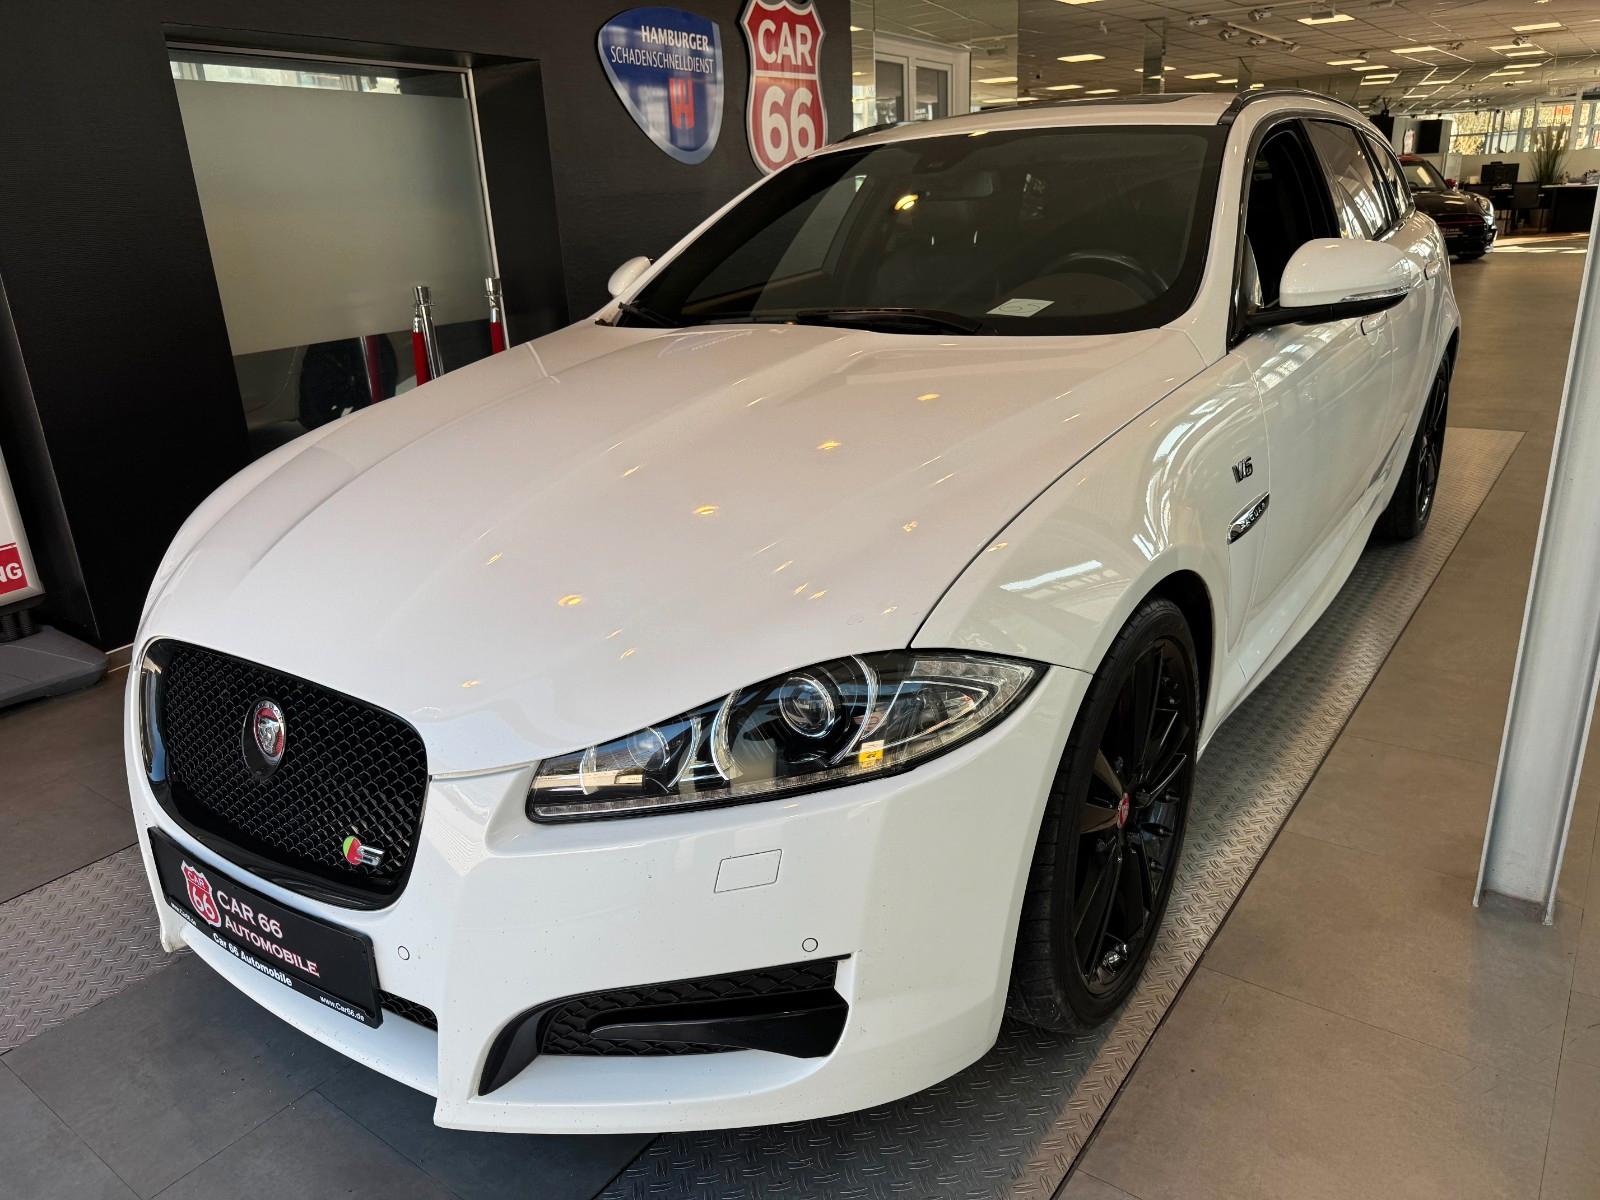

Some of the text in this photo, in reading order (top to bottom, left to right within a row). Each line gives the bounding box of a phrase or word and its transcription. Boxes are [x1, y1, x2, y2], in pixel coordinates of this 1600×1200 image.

[610, 45, 714, 74] SCHADENSCHNELLDIENST
[640, 25, 709, 51] HAMBURGER
[757, 19, 813, 67] CAR
[761, 85, 816, 163] 66
[187, 871, 207, 890] CAR
[192, 886, 216, 920] 66
[217, 890, 283, 939] CAR 66
[212, 932, 227, 949] Car
[240, 950, 293, 987] Automobile
[225, 915, 321, 977] AUTOMOBILE
